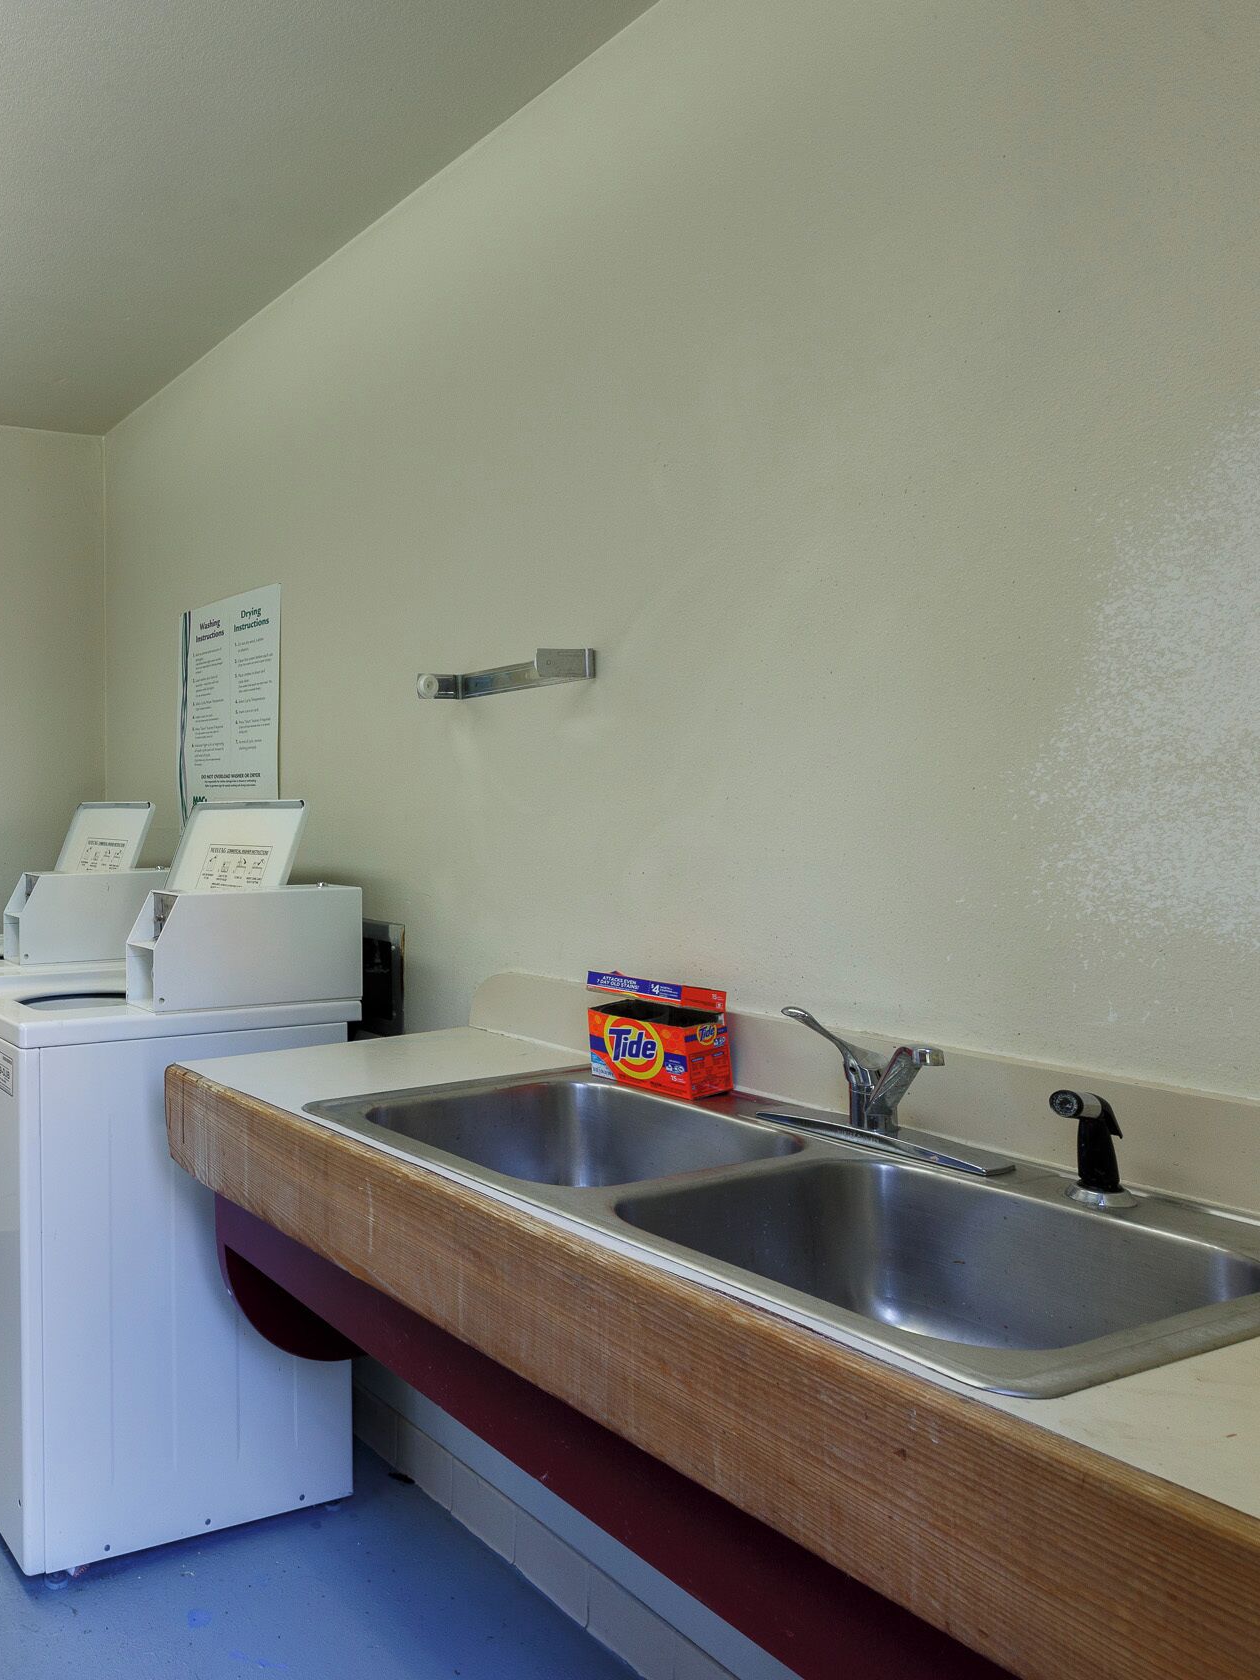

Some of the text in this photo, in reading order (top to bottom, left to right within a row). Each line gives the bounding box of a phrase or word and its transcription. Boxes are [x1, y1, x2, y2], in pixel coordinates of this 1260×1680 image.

[240, 607, 261, 619] Drying
[200, 619, 220, 631] Washing
[234, 617, 269, 632] Instructions
[196, 629, 225, 643] Instructions
[699, 1025, 714, 1041] Tide
[608, 1028, 657, 1062] Tide
